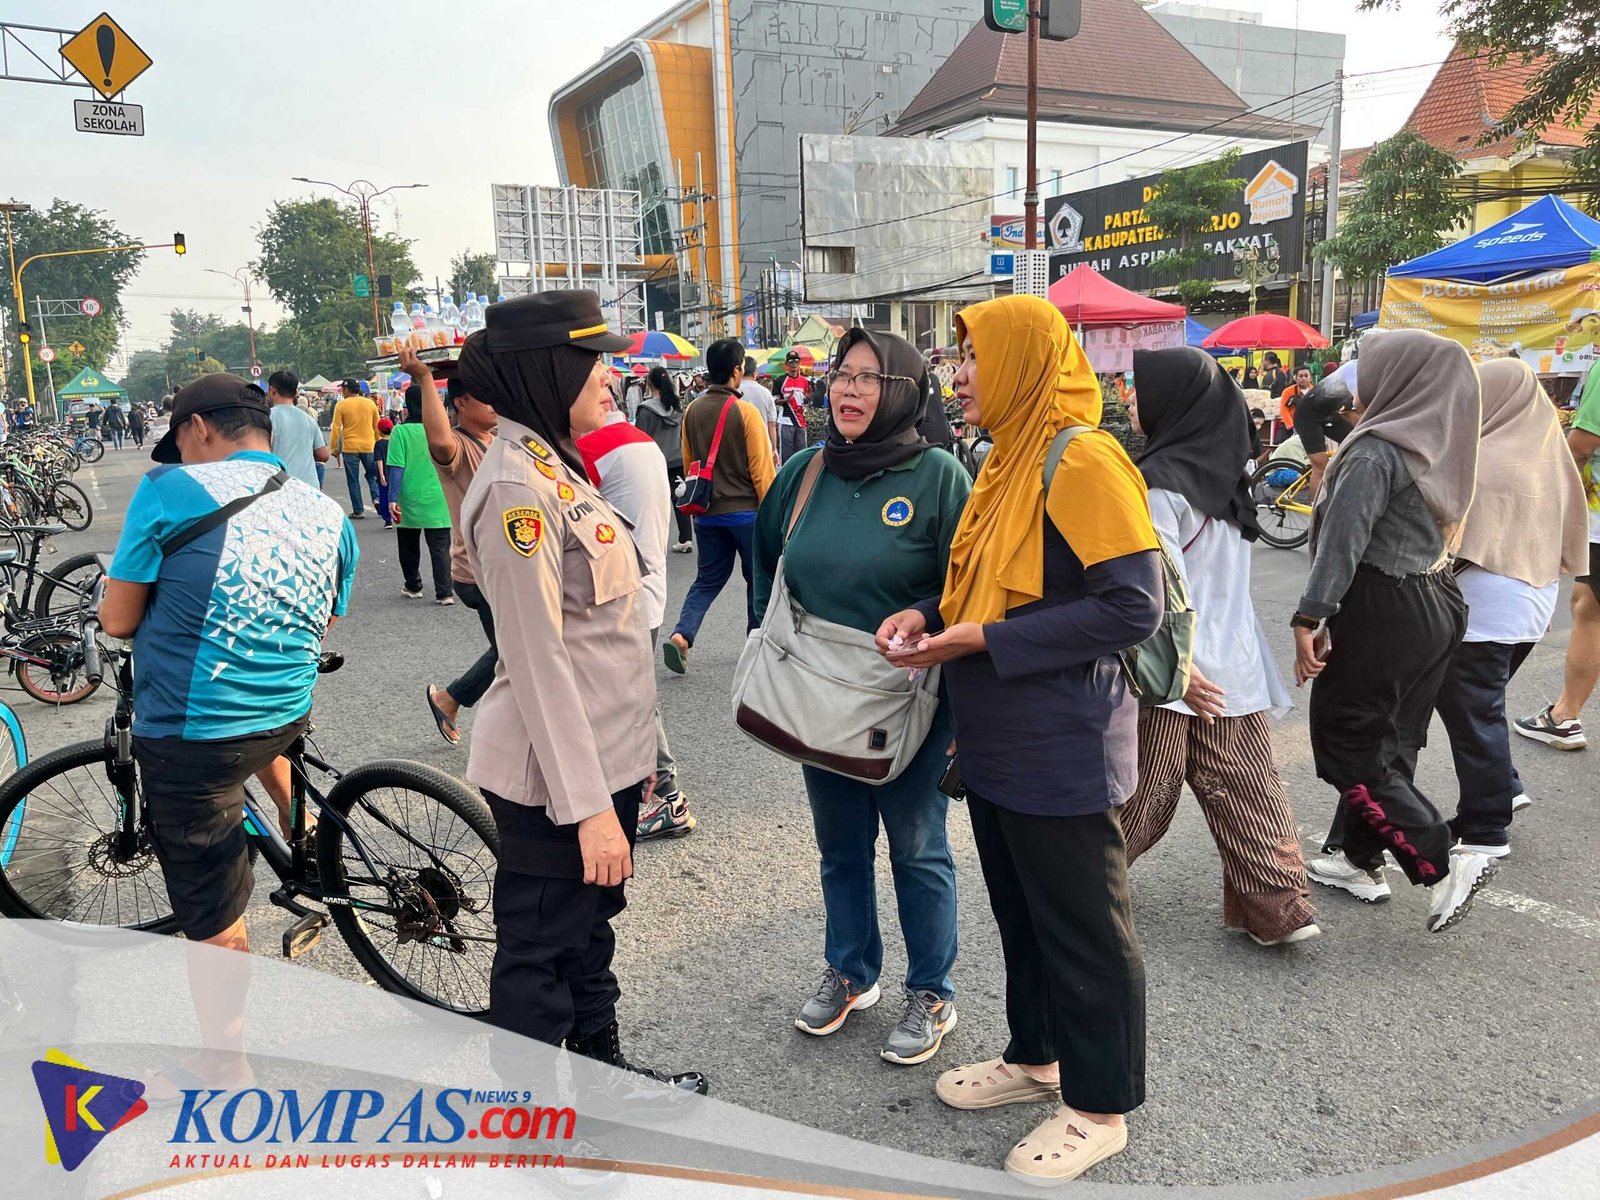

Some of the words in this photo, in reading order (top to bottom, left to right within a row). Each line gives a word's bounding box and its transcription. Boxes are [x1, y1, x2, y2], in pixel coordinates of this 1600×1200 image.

[92, 104, 126, 118] ZONA
[83, 117, 137, 132] SEKOLAH
[1252, 195, 1289, 210] Rumah
[1252, 206, 1289, 223] Aspirasi
[1474, 231, 1548, 248] speeds
[1060, 258, 1111, 276] RUAH
[1421, 283, 1481, 299] PECEL
[507, 510, 540, 520] RESERSE
